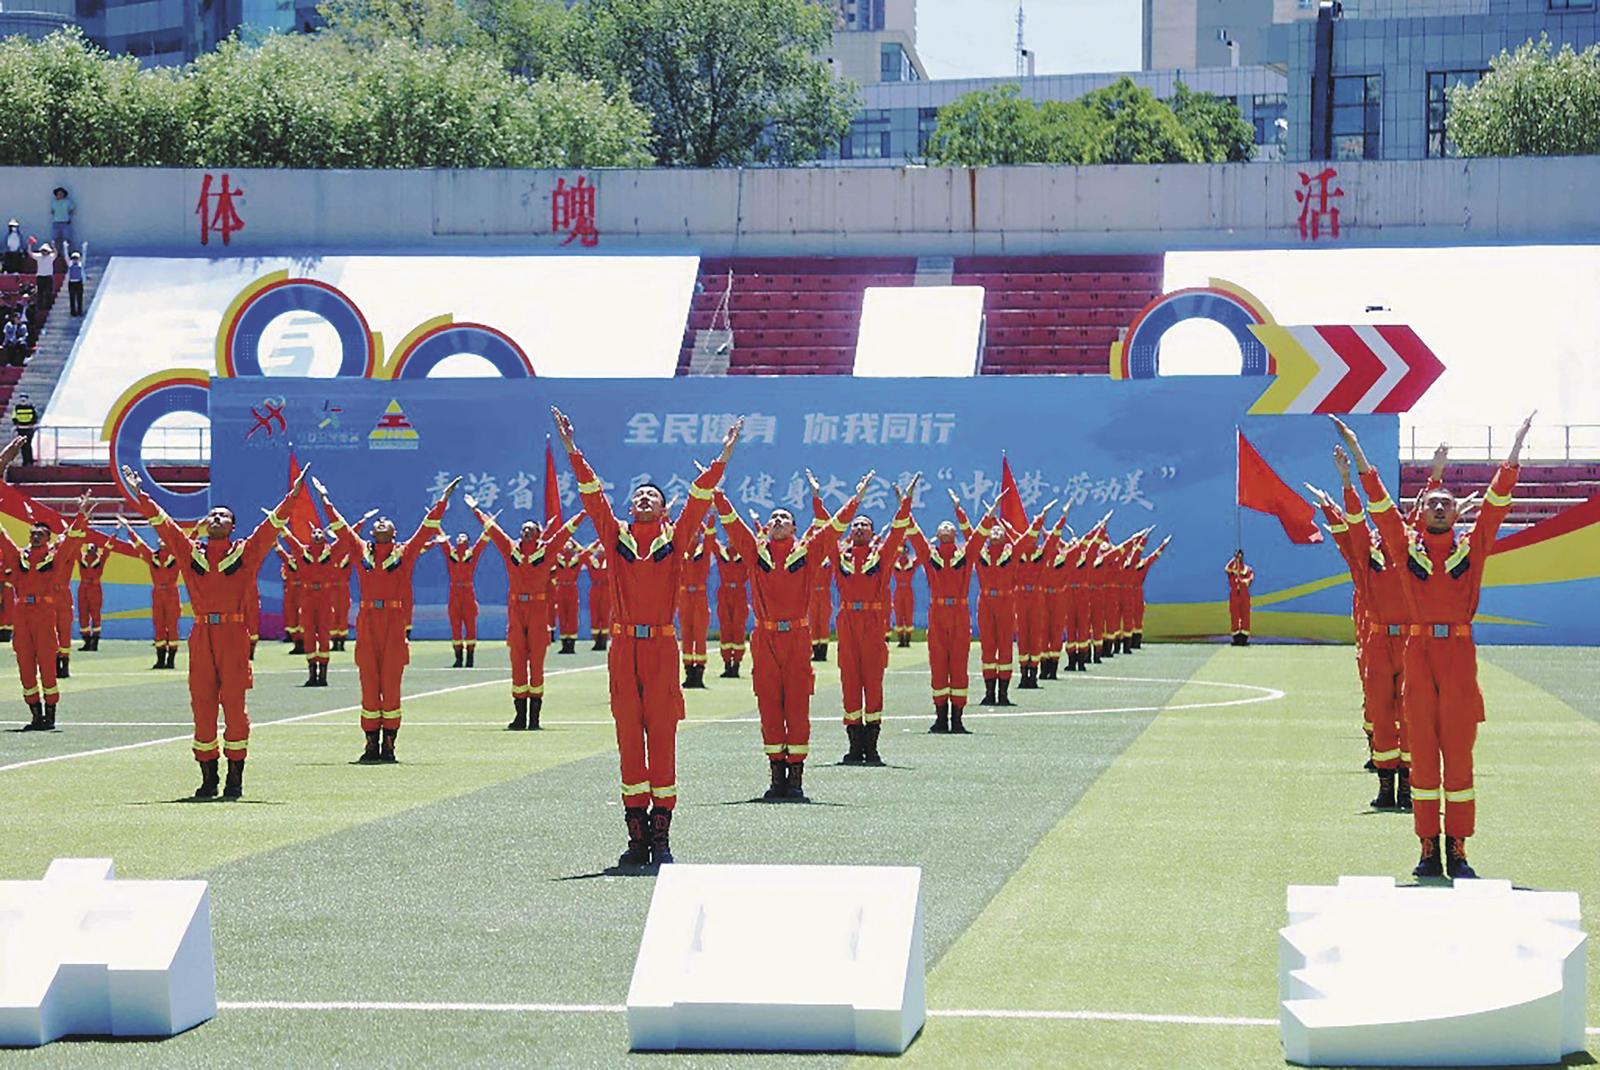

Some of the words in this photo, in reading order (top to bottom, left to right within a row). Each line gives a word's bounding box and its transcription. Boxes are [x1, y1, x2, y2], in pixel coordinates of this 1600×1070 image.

[195, 173, 245, 246] 体
[552, 175, 599, 248] 魄
[1295, 167, 1345, 241] 活
[624, 412, 777, 444] 全民健身
[802, 412, 956, 444] 你我同行
